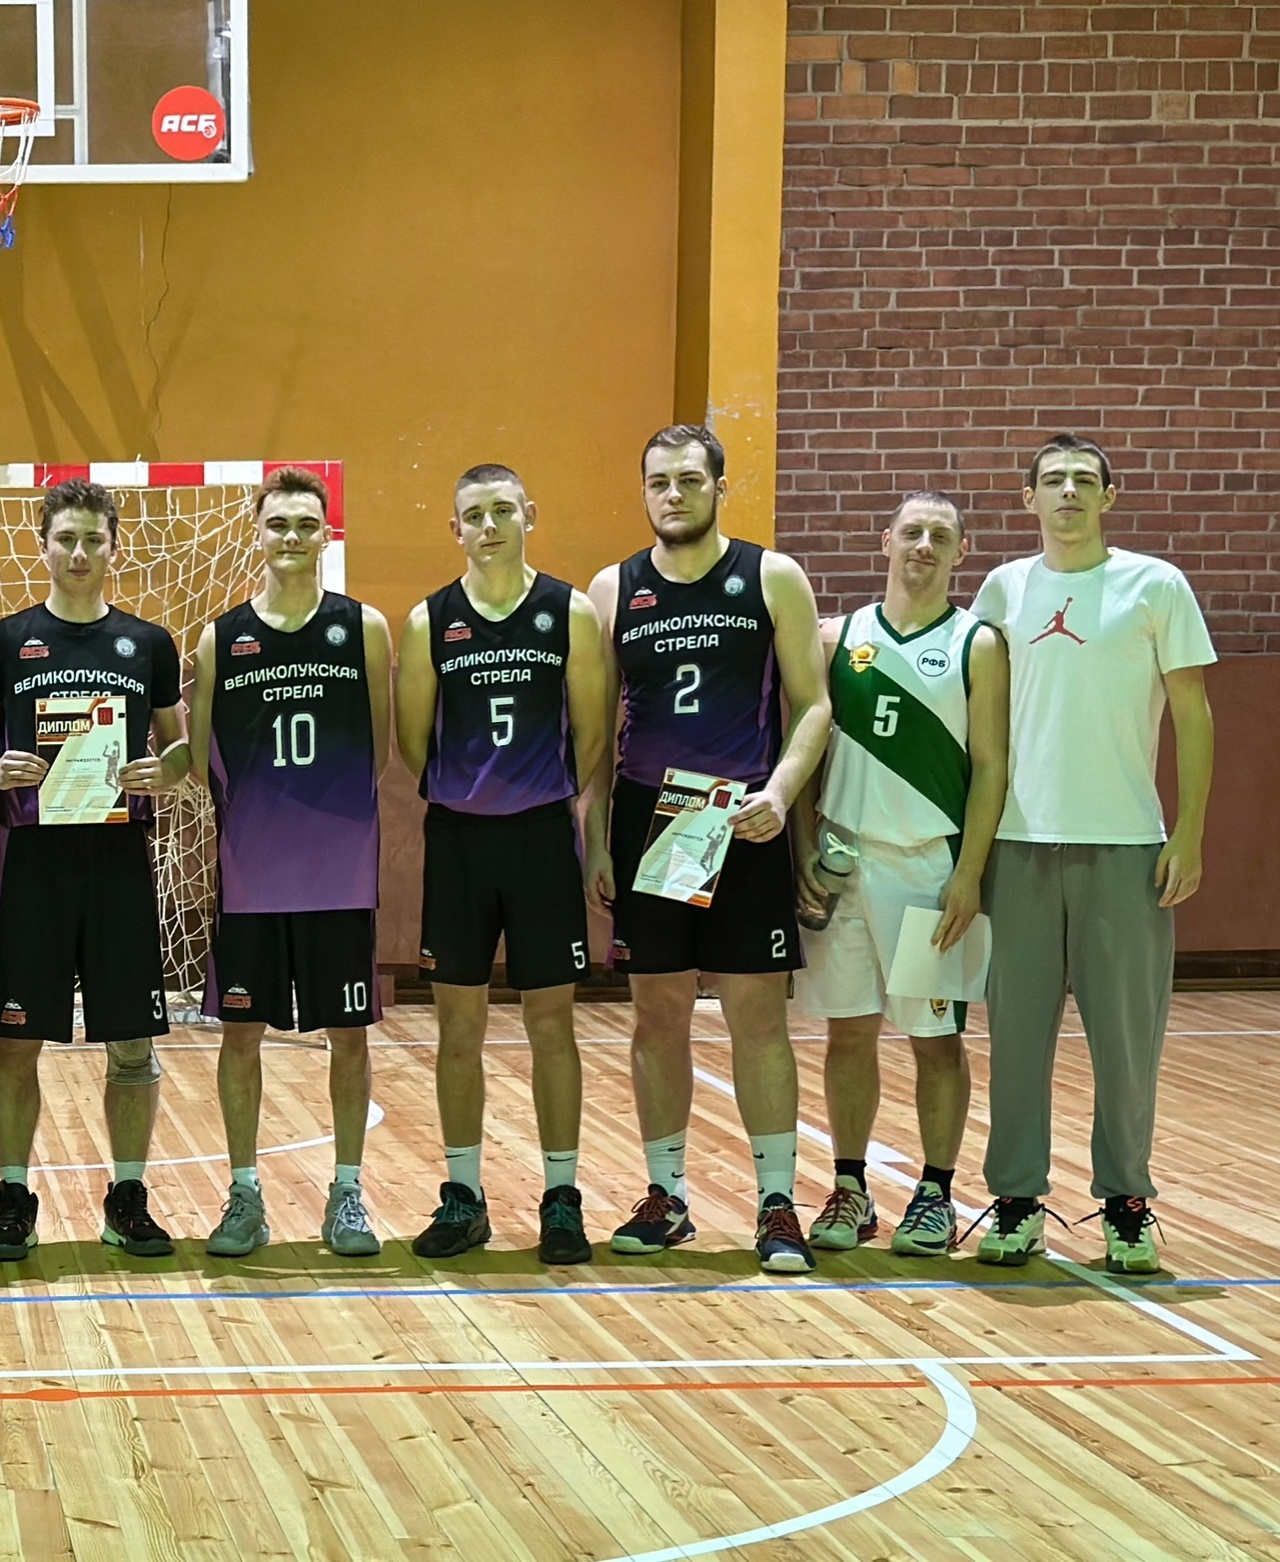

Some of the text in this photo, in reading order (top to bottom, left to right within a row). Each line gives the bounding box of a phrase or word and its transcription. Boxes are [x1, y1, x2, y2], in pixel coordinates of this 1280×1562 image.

[621, 614, 758, 644] ВЕЛИКОЛУКСКАЯ
[654, 634, 719, 653] СТРЕЛА
[440, 648, 563, 674] ВЕЛИКОЛУКСКАЯ
[921, 657, 946, 668] РФБ
[13, 669, 145, 695] ВЕЛИКОЛУКСКАЯ
[223, 663, 358, 691] ВЕЛИКОЛУКСКАЯ
[470, 669, 531, 685] СТРЕЛА
[674, 664, 701, 714] 2
[262, 685, 324, 702] СТРЕЛА
[37, 719, 91, 735] ДИПЛОМ
[490, 696, 514, 747] 5
[872, 694, 901, 737] 5
[272, 713, 316, 767] 10
[657, 791, 707, 809] ДИПЛОМ
[571, 941, 586, 970] 5
[771, 929, 787, 958] 2
[151, 990, 163, 1020] 3
[343, 981, 367, 1012] 10
